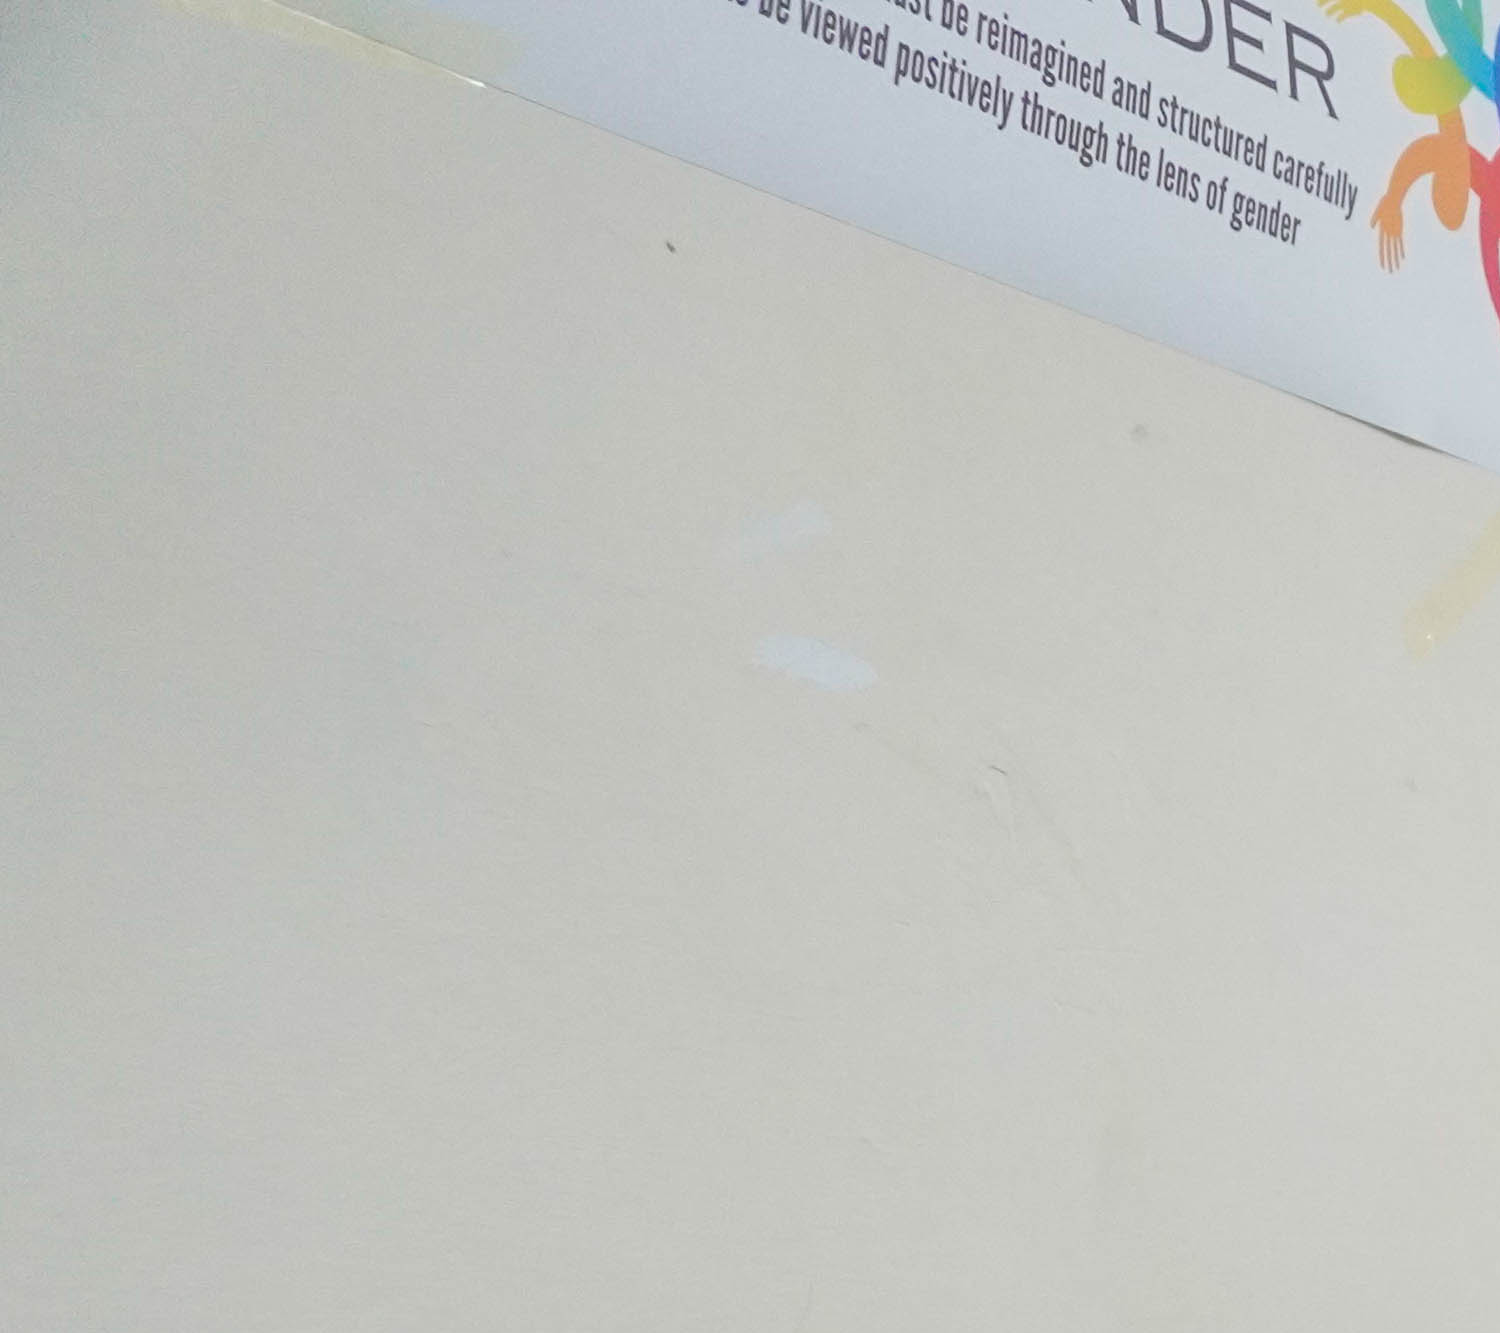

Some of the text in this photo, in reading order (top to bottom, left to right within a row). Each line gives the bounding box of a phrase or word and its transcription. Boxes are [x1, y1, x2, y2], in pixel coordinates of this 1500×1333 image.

[800, 1, 889, 68] viewed
[894, 41, 1013, 130] positively
[1021, 91, 1108, 167] through
[1116, 131, 1150, 181] the
[1156, 149, 1200, 202] lens
[1206, 176, 1229, 214] of
[1230, 190, 1301, 246] gender
[941, 0, 968, 36] be
[976, 11, 1106, 100] reimagined
[1111, 76, 1151, 120] and
[1157, 96, 1267, 172] structured
[1273, 149, 1357, 220] carefully
[1085, 0, 1339, 120] DER
